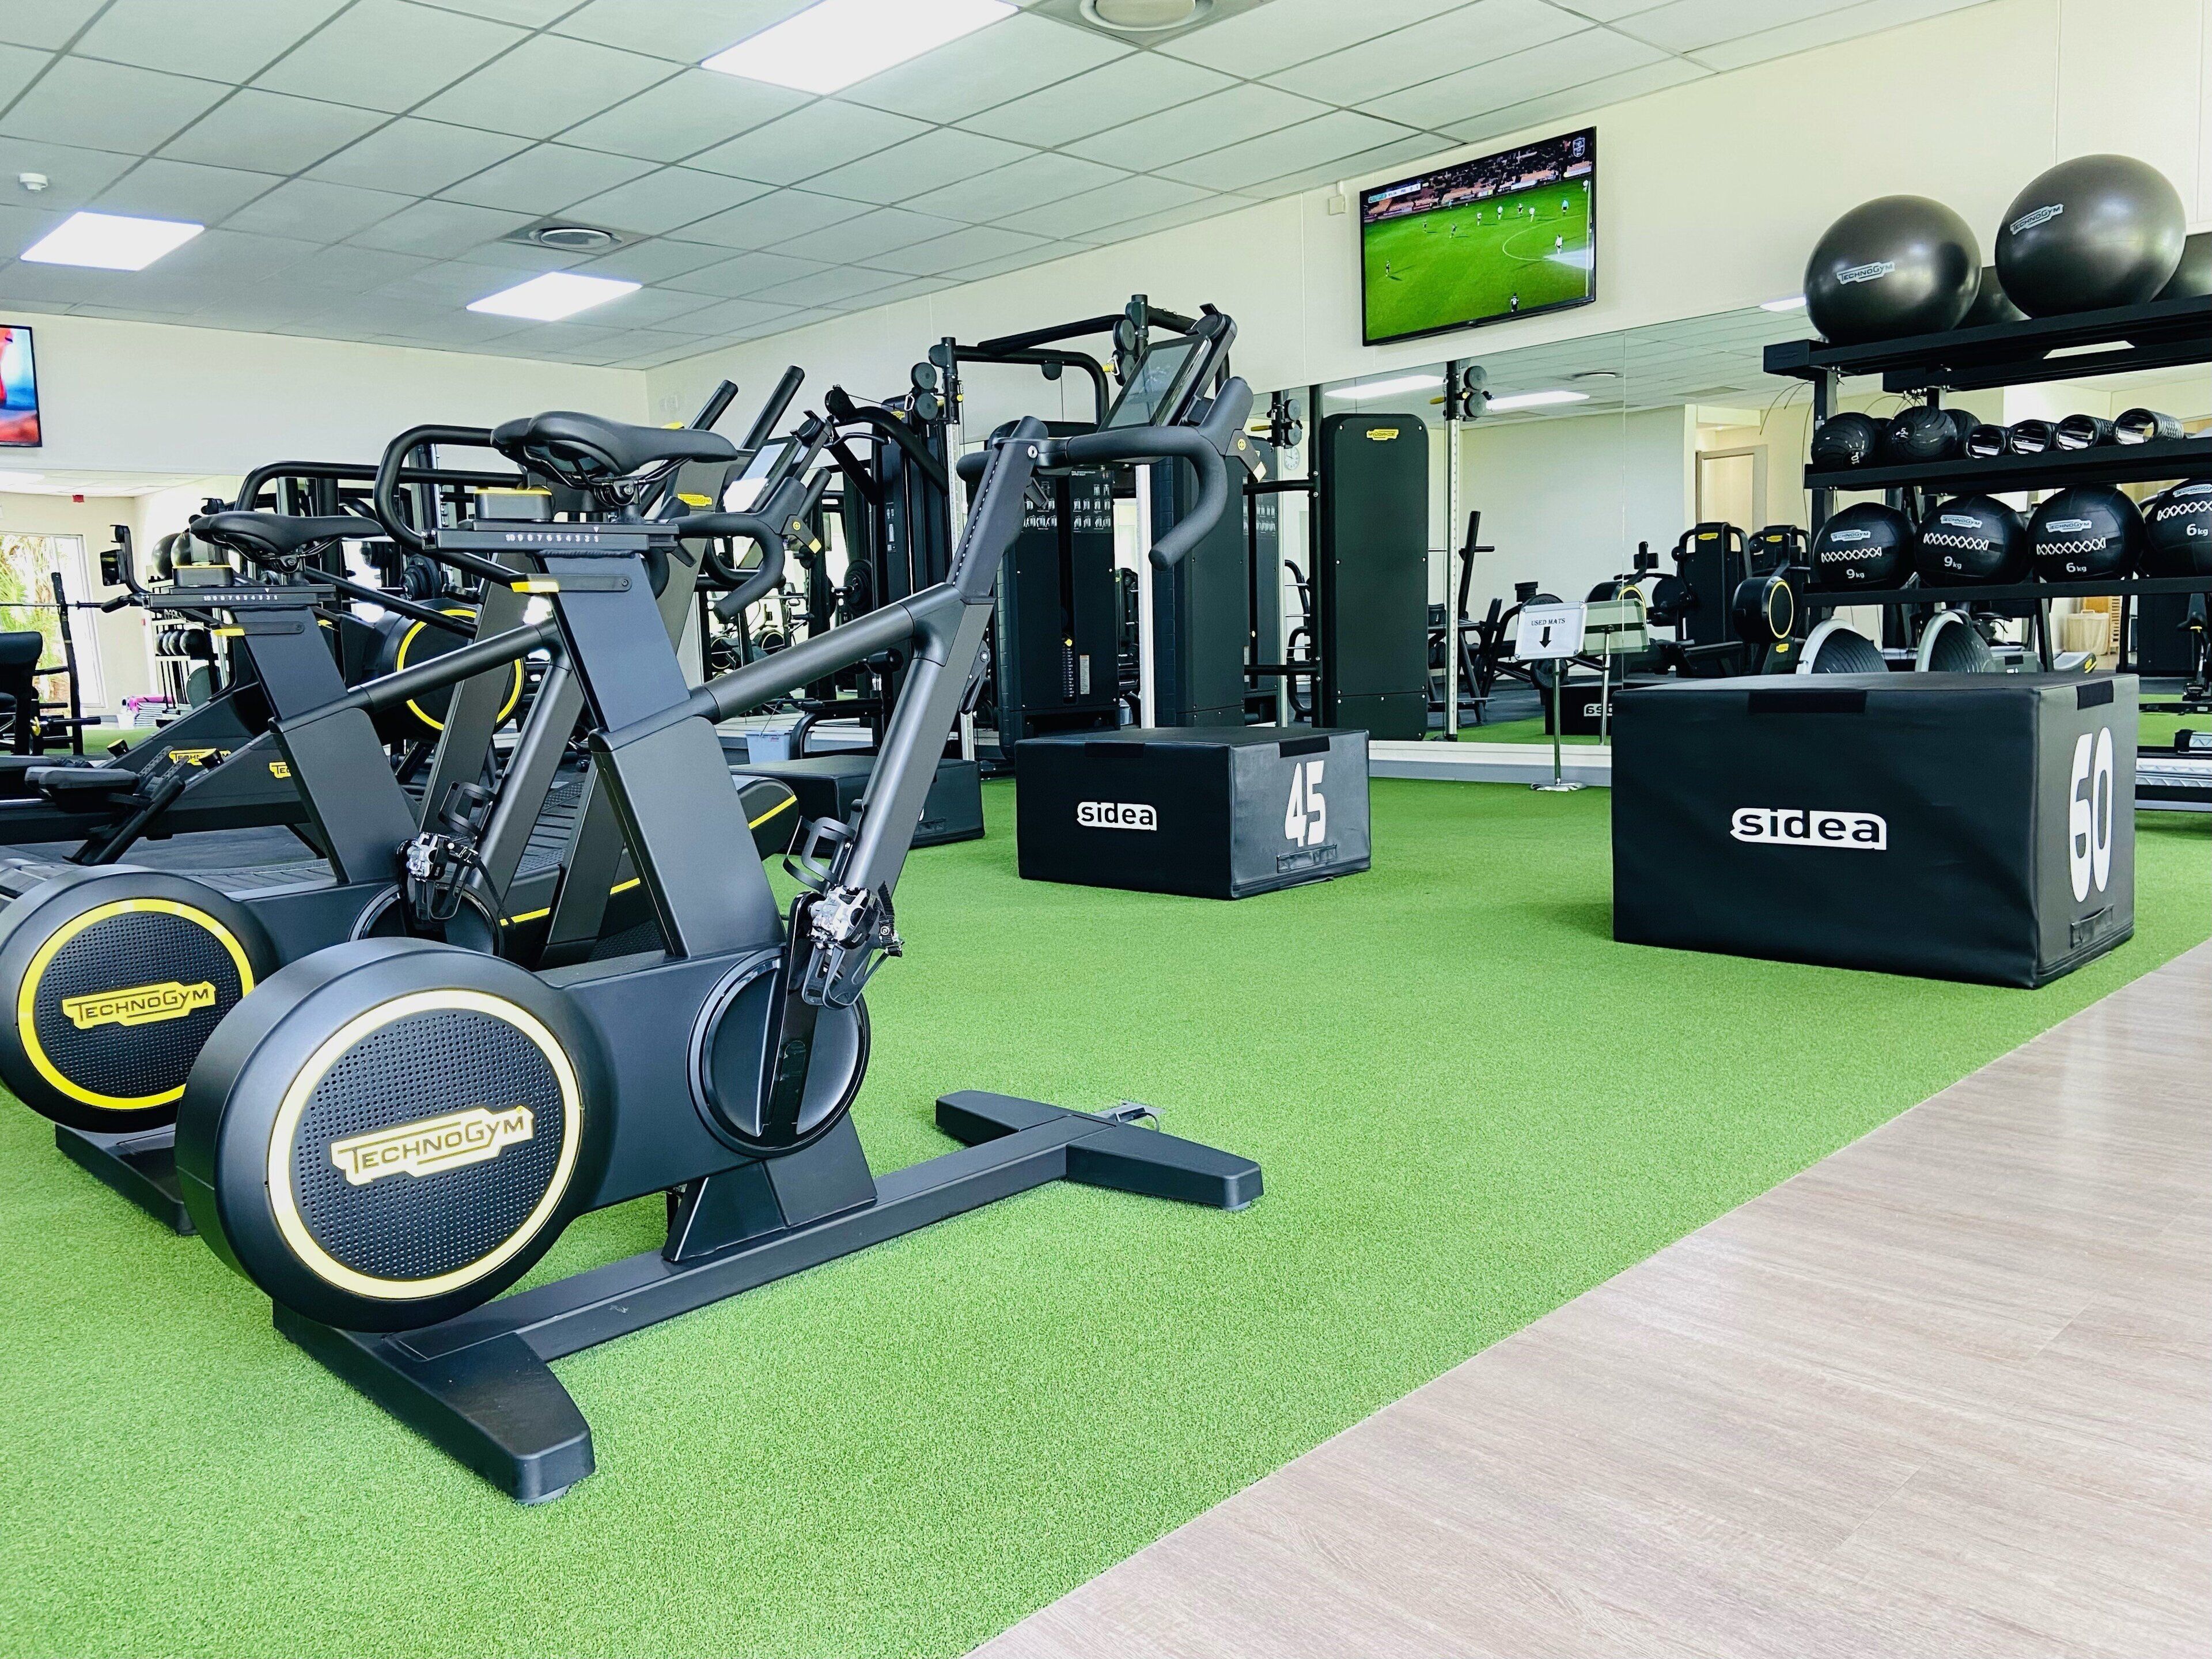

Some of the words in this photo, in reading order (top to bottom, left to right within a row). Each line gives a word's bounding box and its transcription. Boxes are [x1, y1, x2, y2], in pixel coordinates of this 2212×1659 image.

[1081, 801, 1154, 825] sidea
[1285, 760, 1326, 847] 45
[1738, 809, 1880, 843] sidea
[2069, 726, 2113, 903] 60
[67, 987, 209, 1022] TECHNOGYM
[337, 1115, 524, 1176] TECHNOGYM
